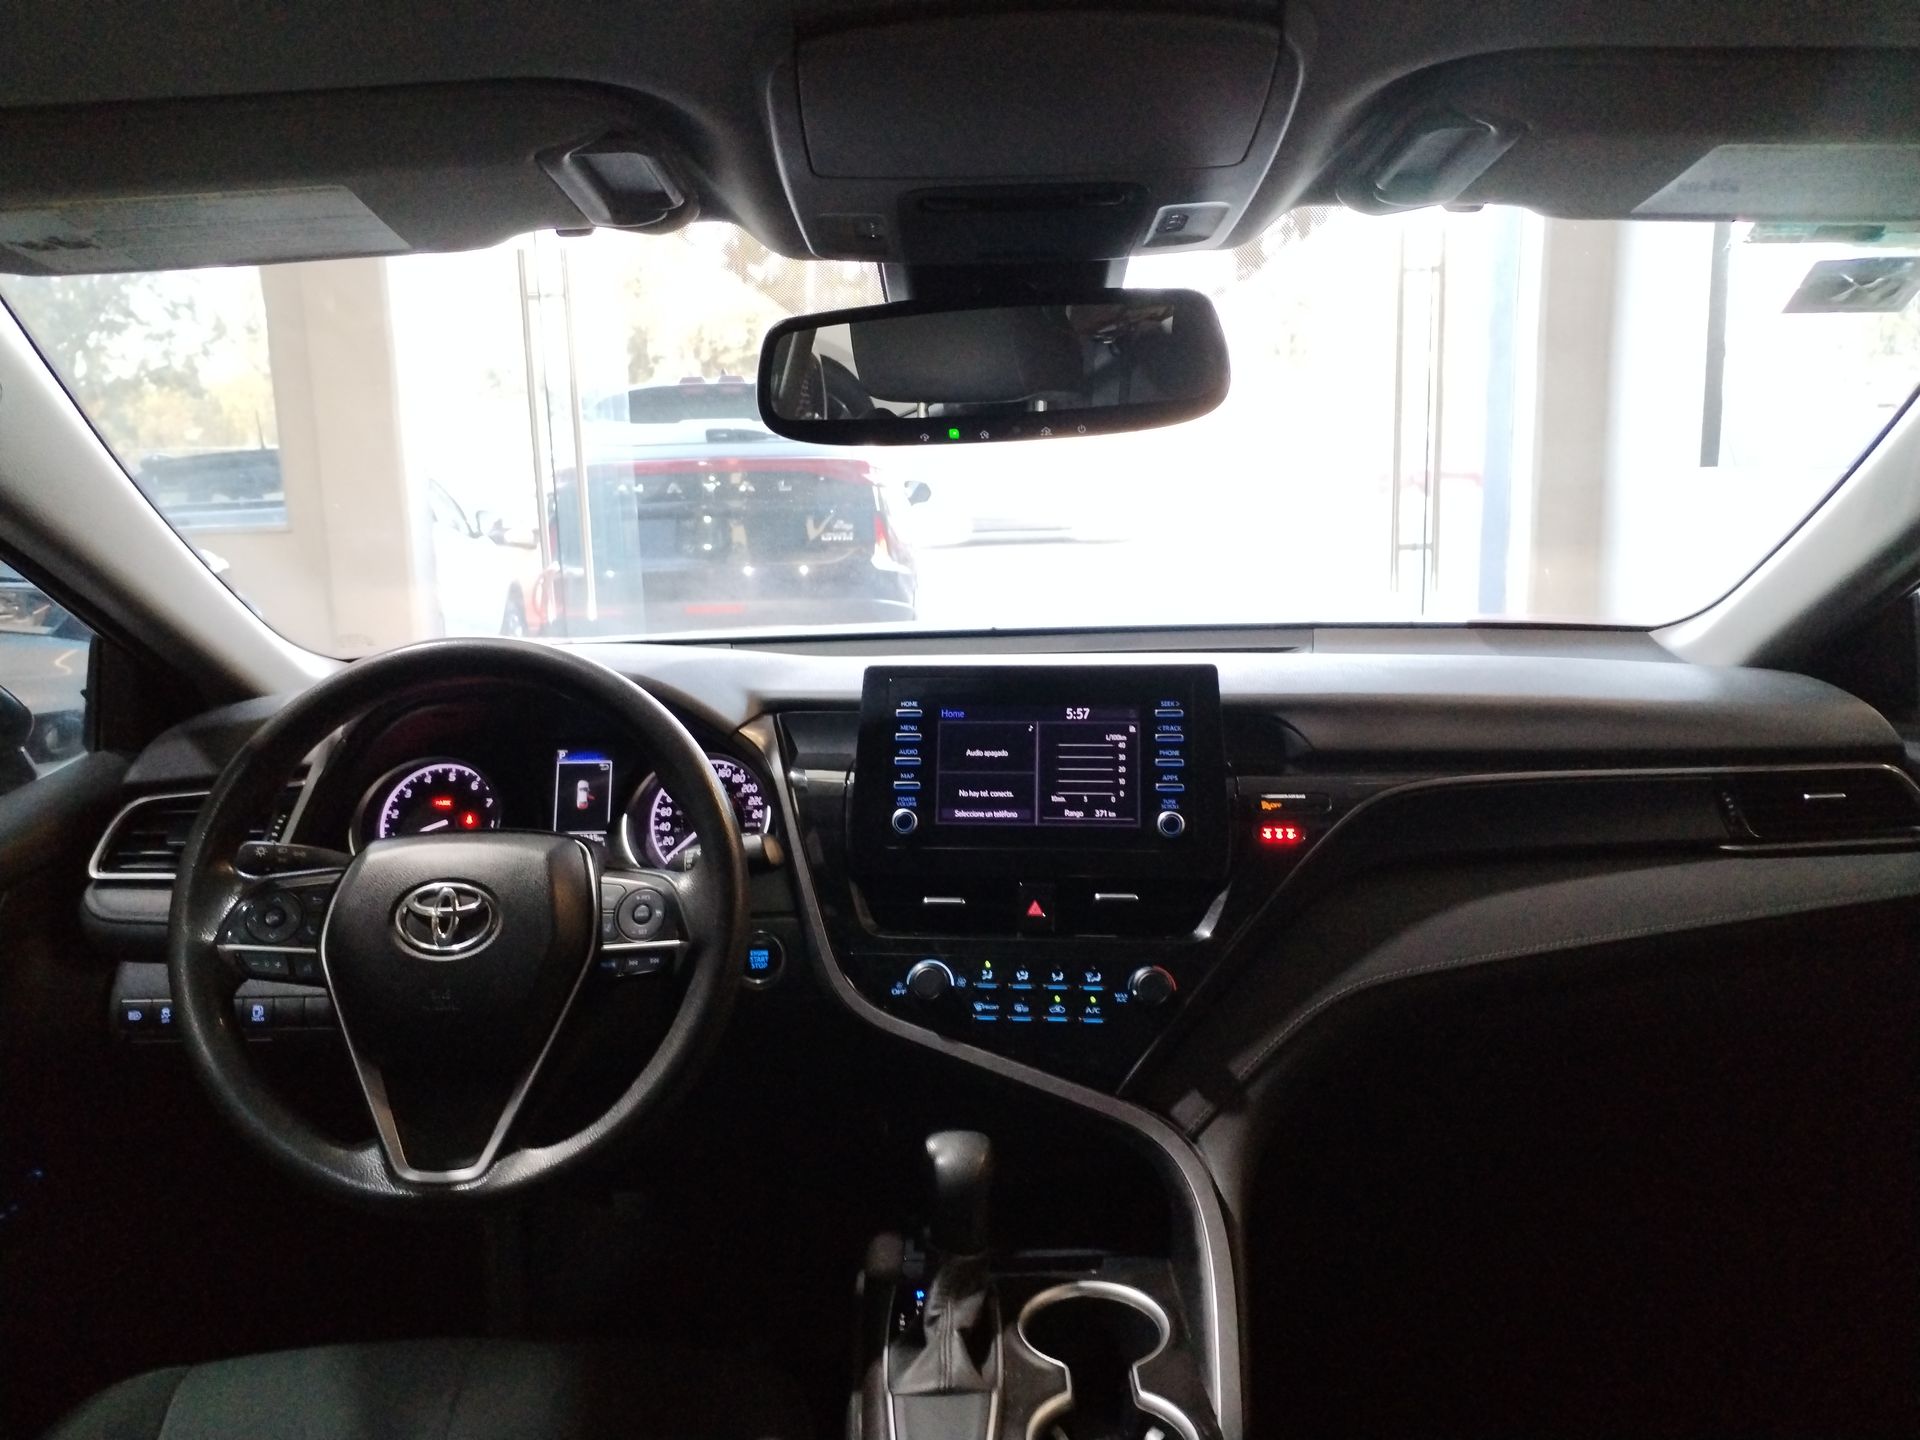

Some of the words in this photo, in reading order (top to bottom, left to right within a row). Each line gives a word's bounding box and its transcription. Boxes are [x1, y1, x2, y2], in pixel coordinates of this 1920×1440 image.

[941, 709, 965, 718] Home
[1066, 708, 1090, 720] 5:57
[966, 749, 983, 757] Audio
[984, 749, 1009, 758] apagado
[424, 774, 432, 784] 4
[448, 772, 457, 781] 5
[471, 781, 479, 791] 6
[741, 783, 758, 793] 200
[404, 789, 412, 799] 3
[959, 789, 969, 797] No
[969, 790, 979, 798] hay
[486, 797, 493, 808] 7
[955, 810, 984, 818] Seleccione
[1064, 808, 1084, 818] Rango
[1095, 809, 1107, 817] 371
[662, 836, 675, 846] 20
